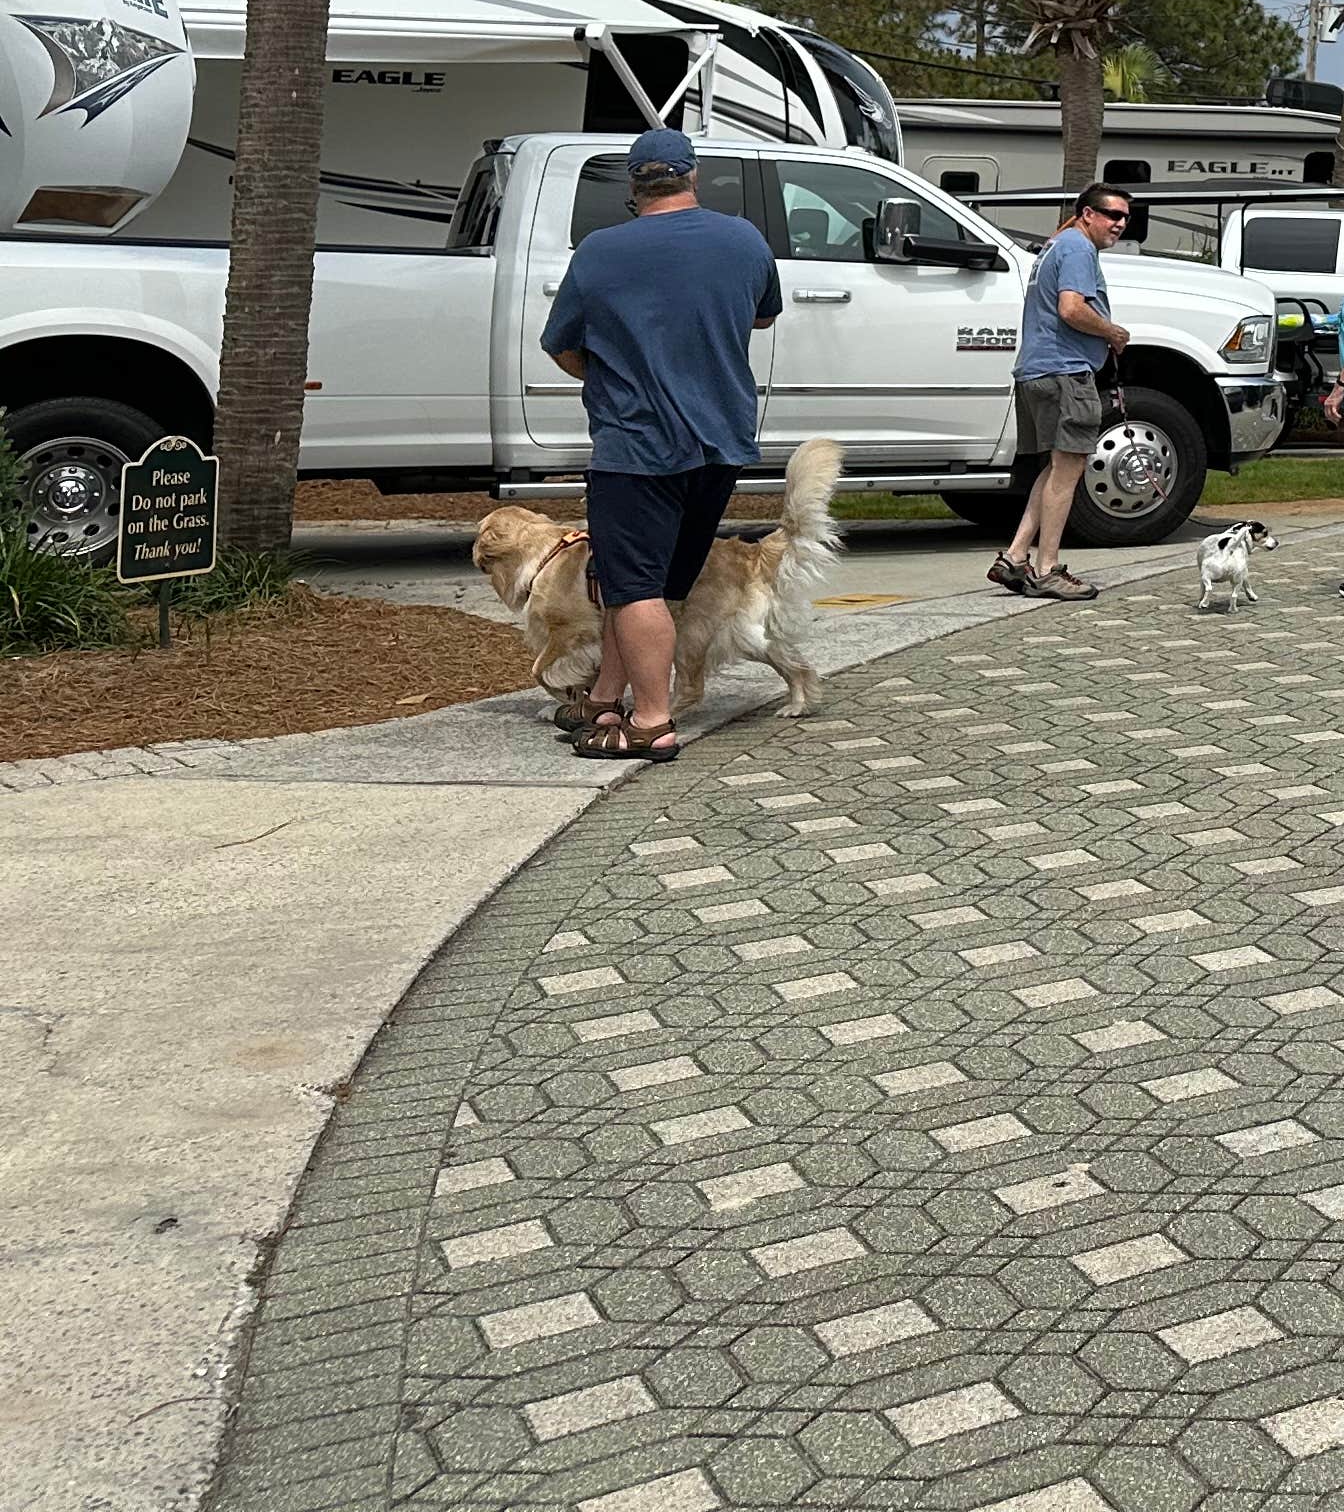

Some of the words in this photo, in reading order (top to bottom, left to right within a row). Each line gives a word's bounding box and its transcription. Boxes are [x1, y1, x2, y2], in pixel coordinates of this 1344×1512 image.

[332, 69, 446, 86] EAGLE
[1167, 160, 1269, 174] EAGLE
[958, 327, 1017, 336] RAM
[152, 469, 190, 486] Please
[132, 494, 151, 511] Do
[155, 492, 176, 509] not
[180, 487, 207, 511] park
[127, 521, 144, 535] on
[149, 514, 169, 533] the
[172, 512, 210, 529] Grass.
[134, 539, 171, 561] Thank
[173, 537, 202, 561] you!
